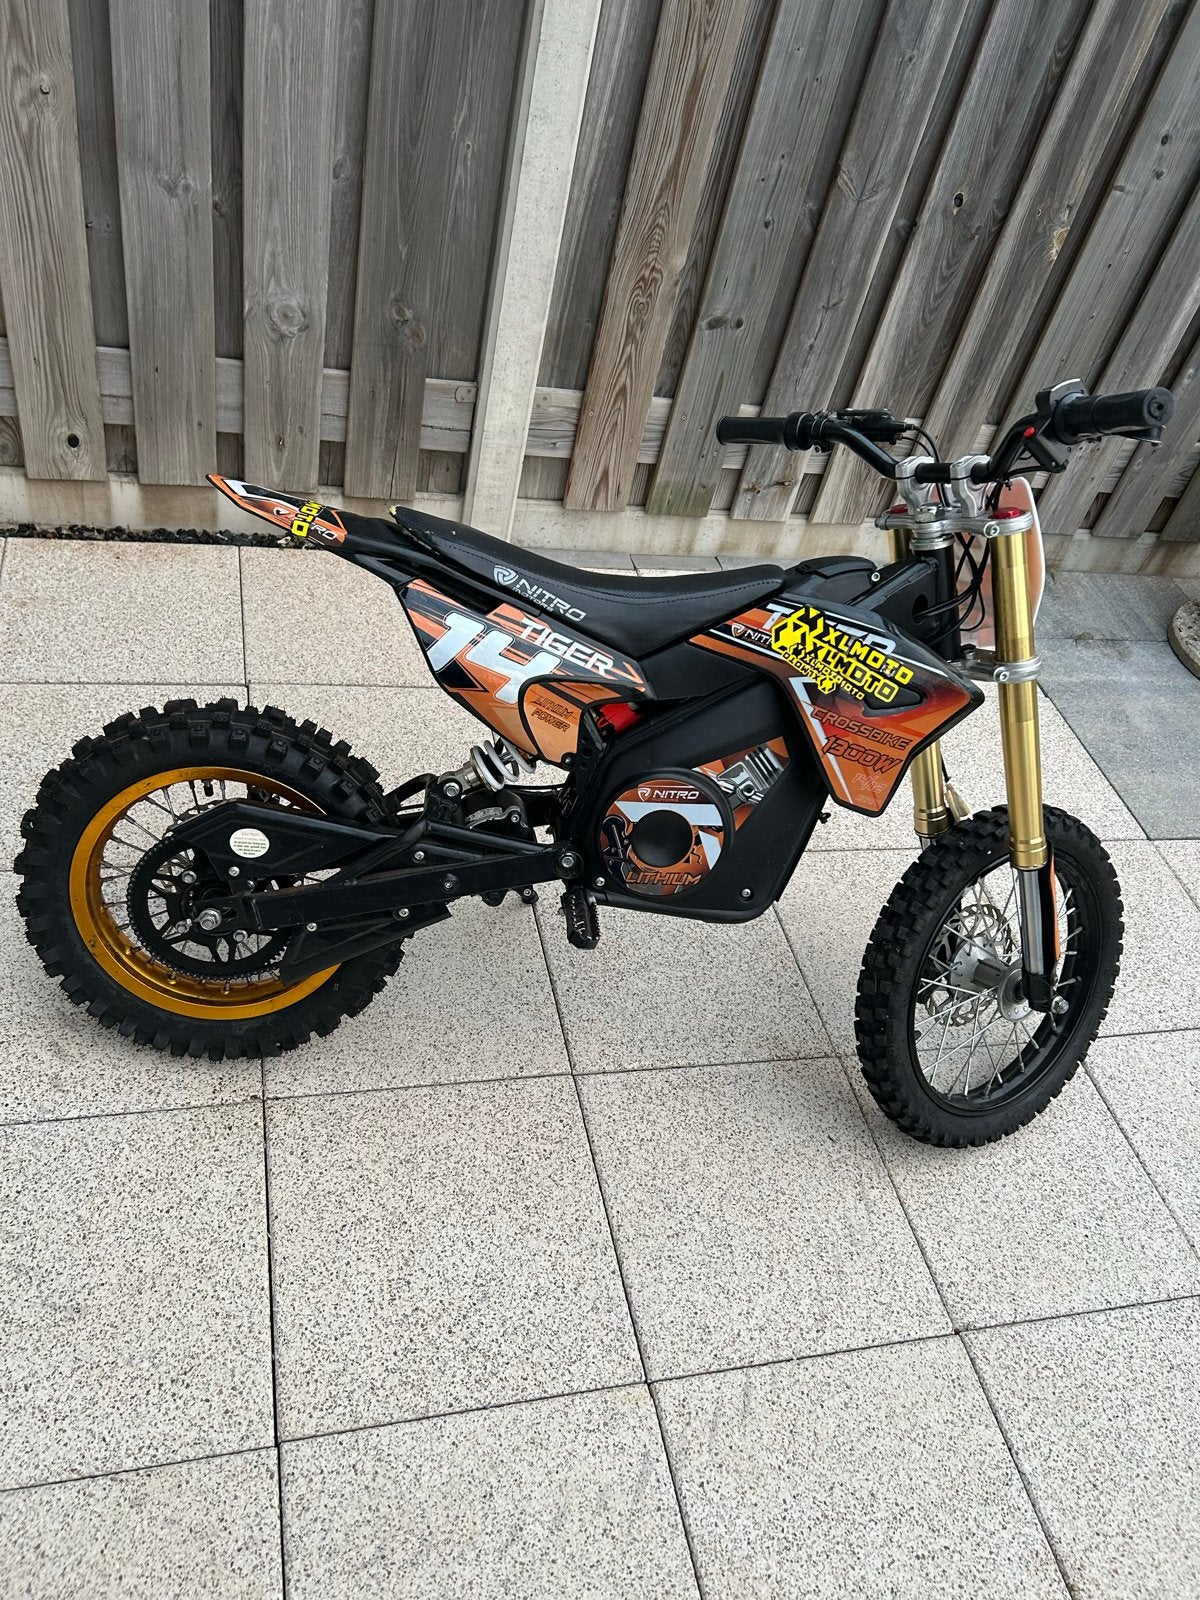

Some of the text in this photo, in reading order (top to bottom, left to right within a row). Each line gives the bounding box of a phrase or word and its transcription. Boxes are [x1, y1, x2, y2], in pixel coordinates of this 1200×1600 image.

[513, 587, 554, 612] MOTORS
[516, 579, 586, 621] NITRO
[426, 611, 562, 705] 14
[518, 617, 616, 677] TIGER
[823, 627, 914, 686] XLMOTO
[807, 641, 899, 702] XLMOTO
[530, 695, 574, 719] LITHIUM
[530, 707, 571, 732] POWER
[810, 707, 913, 751] CROSSBIKE
[821, 734, 904, 774] 1300W
[652, 789, 700, 800] NITRO
[625, 871, 703, 886] LITHIUM
